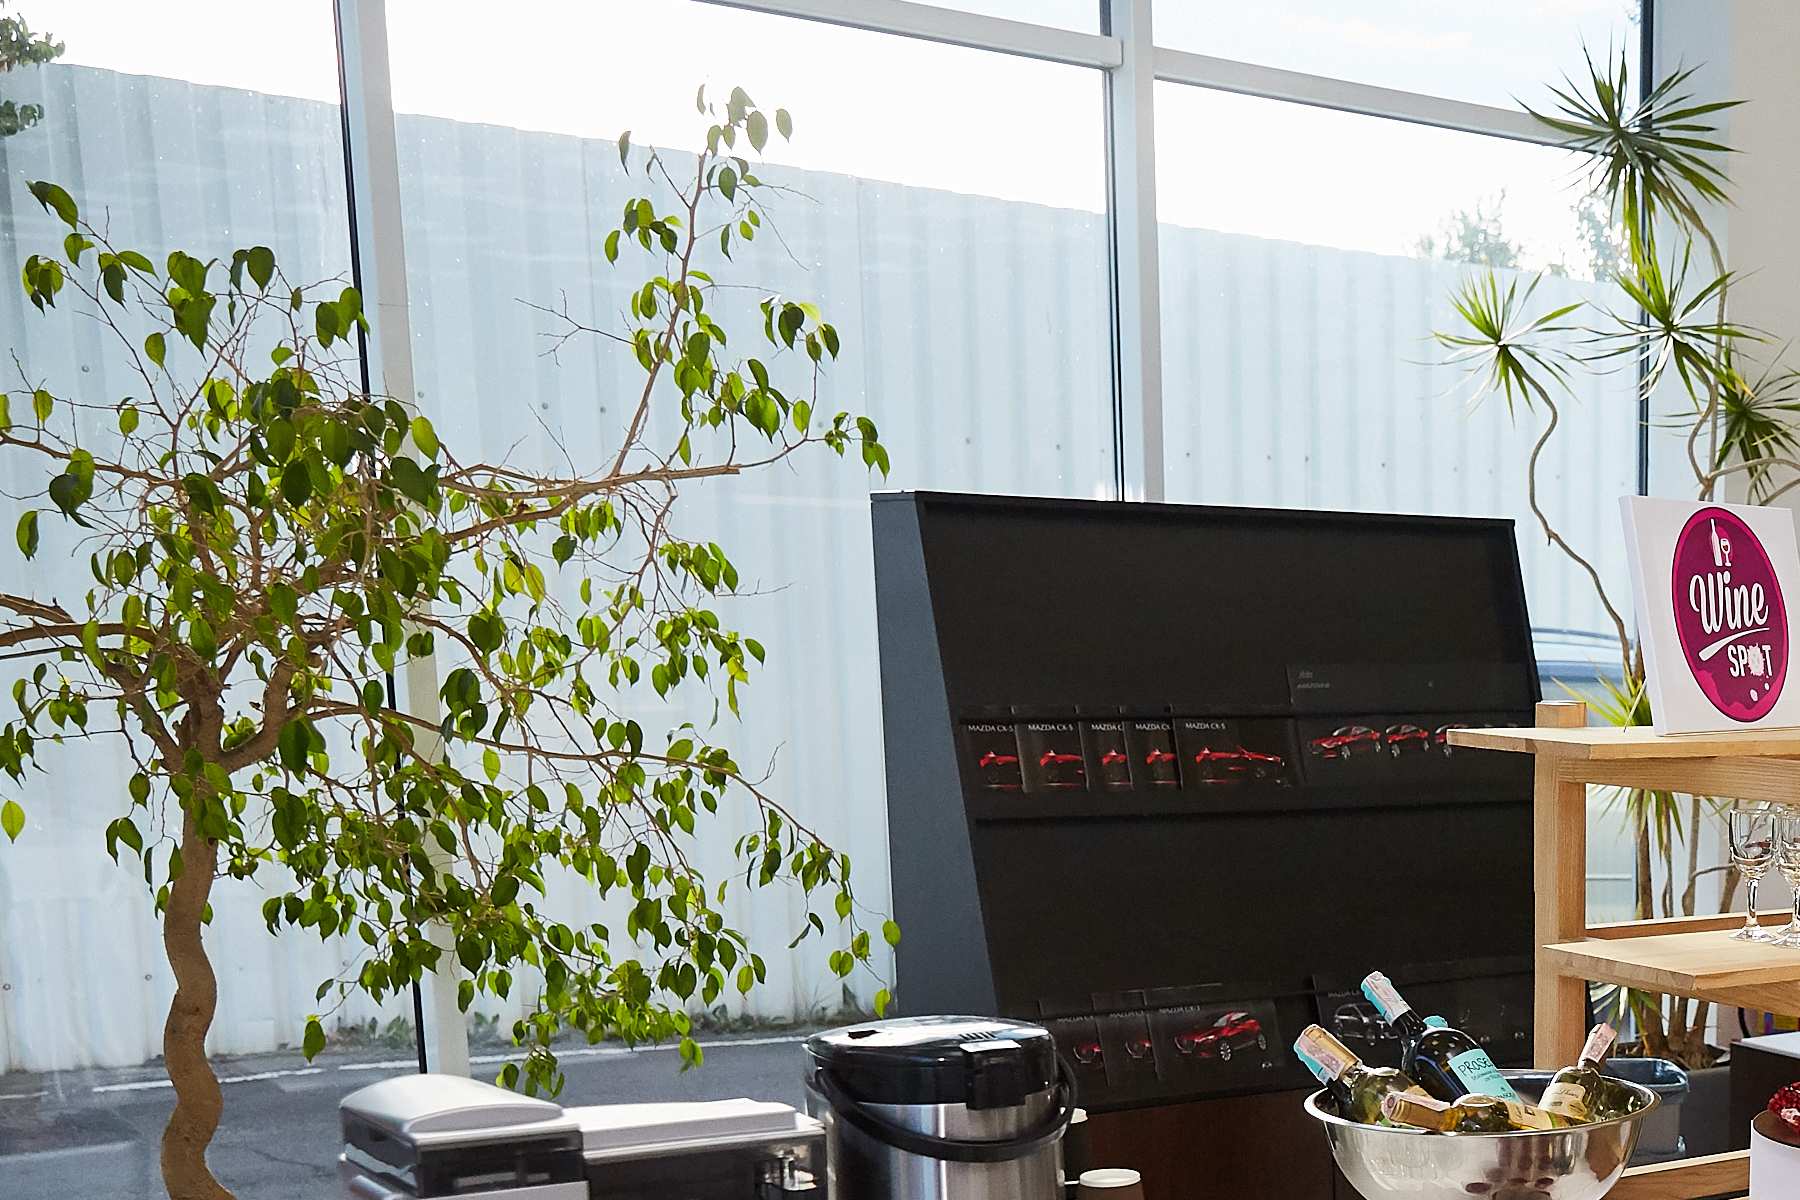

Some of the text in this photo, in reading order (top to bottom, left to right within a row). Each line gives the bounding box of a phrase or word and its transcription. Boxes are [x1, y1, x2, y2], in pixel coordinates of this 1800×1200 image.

[1689, 570, 1769, 634] Wine
[1727, 642, 1773, 678] SPOT
[968, 724, 996, 732] MAZDA
[1028, 723, 1056, 731] MAZDA
[1091, 723, 1117, 731] MAZDA
[1135, 723, 1160, 731] MAZDA
[1185, 722, 1210, 730] MAZDA
